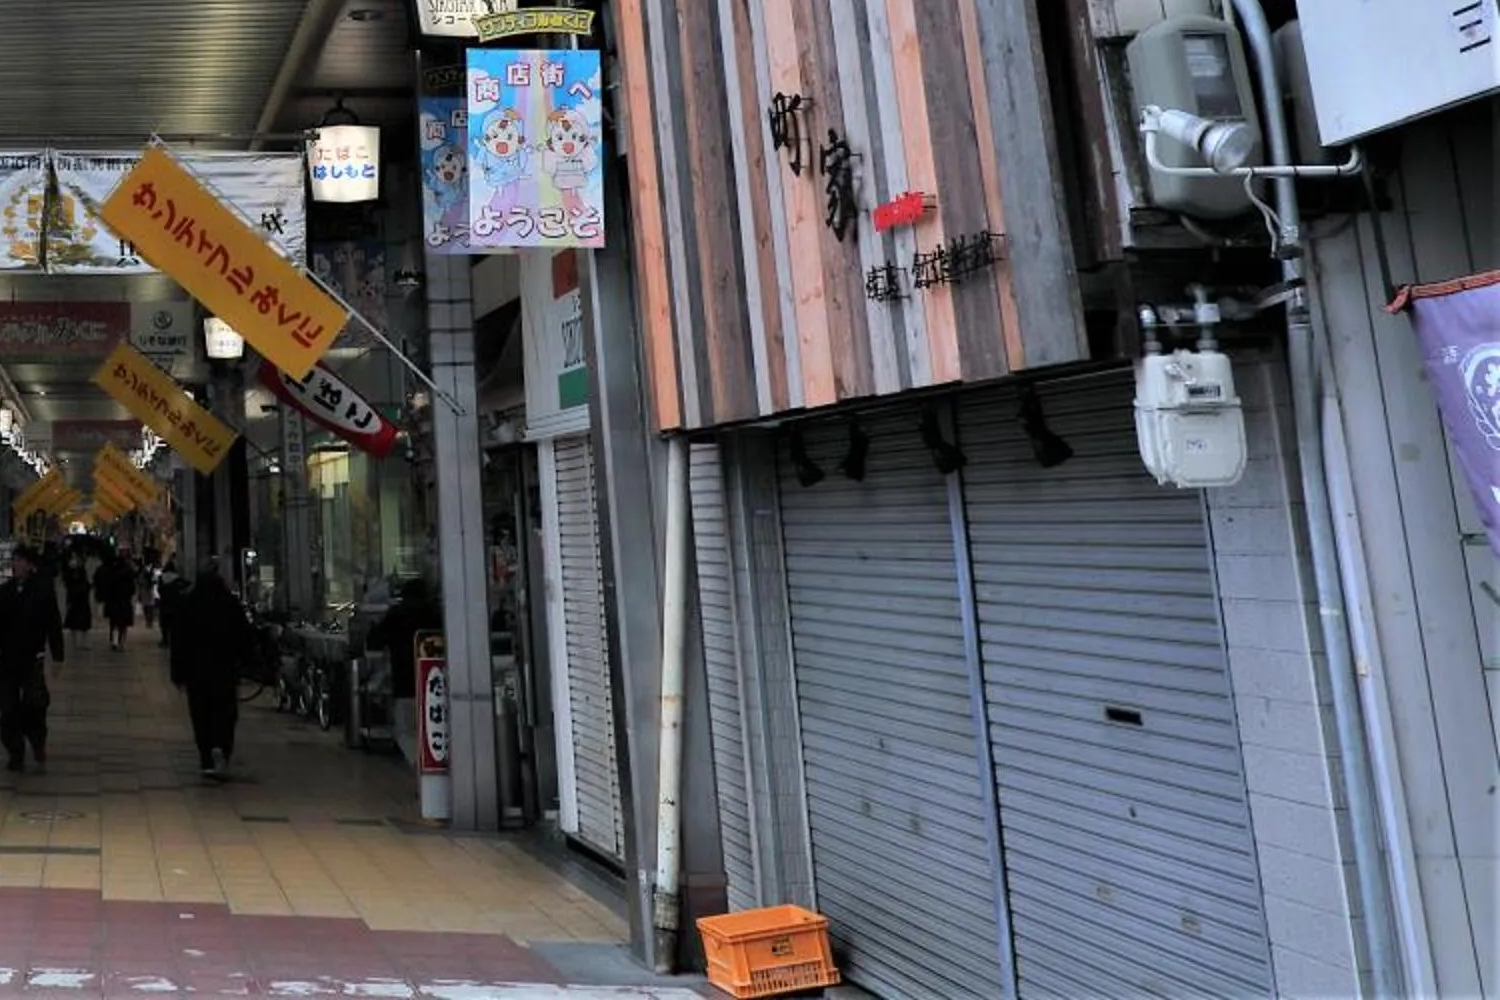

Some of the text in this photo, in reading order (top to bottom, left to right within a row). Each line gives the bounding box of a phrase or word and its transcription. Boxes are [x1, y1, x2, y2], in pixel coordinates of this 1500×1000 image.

[474, 61, 593, 103] 商店街へ
[317, 145, 370, 160] たばこ
[312, 163, 376, 181] はしもと
[473, 206, 600, 239] ようこそ
